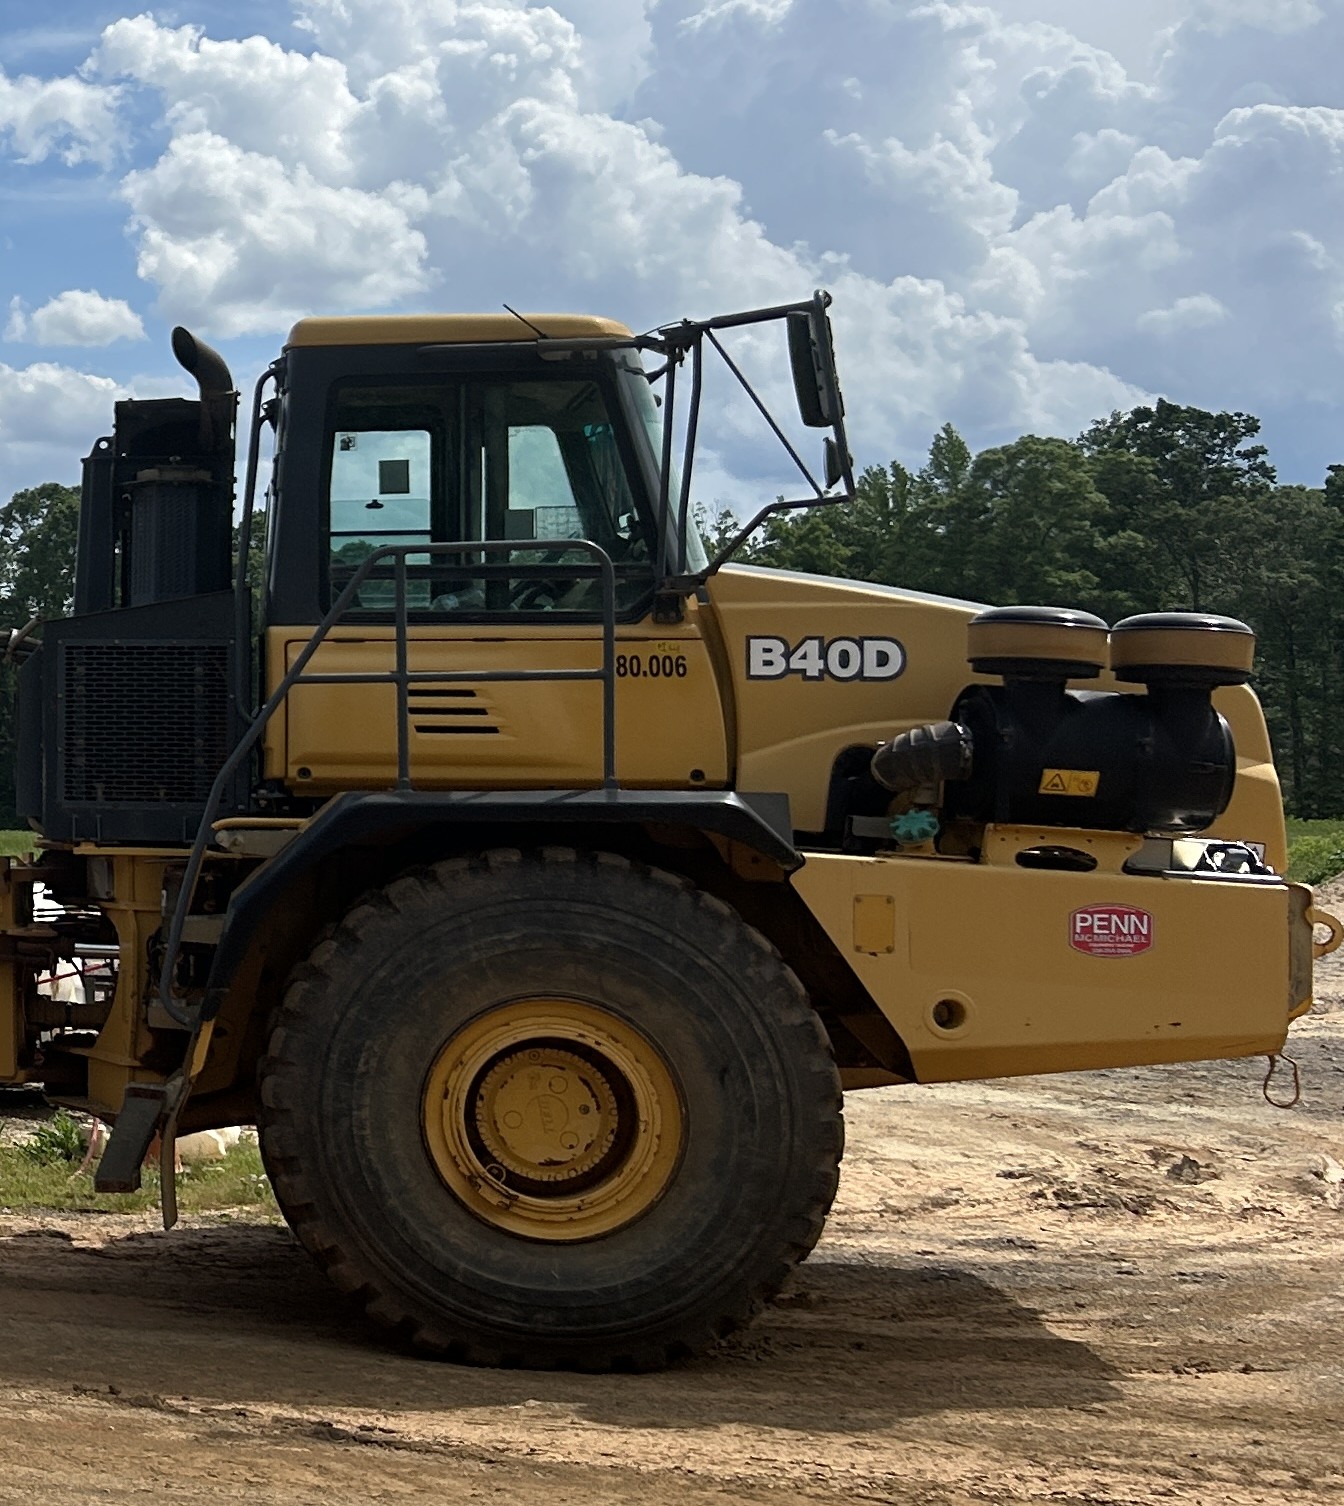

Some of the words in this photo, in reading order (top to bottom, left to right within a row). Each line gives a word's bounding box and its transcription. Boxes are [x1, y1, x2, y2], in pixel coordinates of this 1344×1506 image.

[615, 654, 688, 678] 80.006
[746, 635, 906, 681] B40D
[1075, 913, 1148, 935] PENN
[1074, 934, 1149, 944] MCMICHAEL
